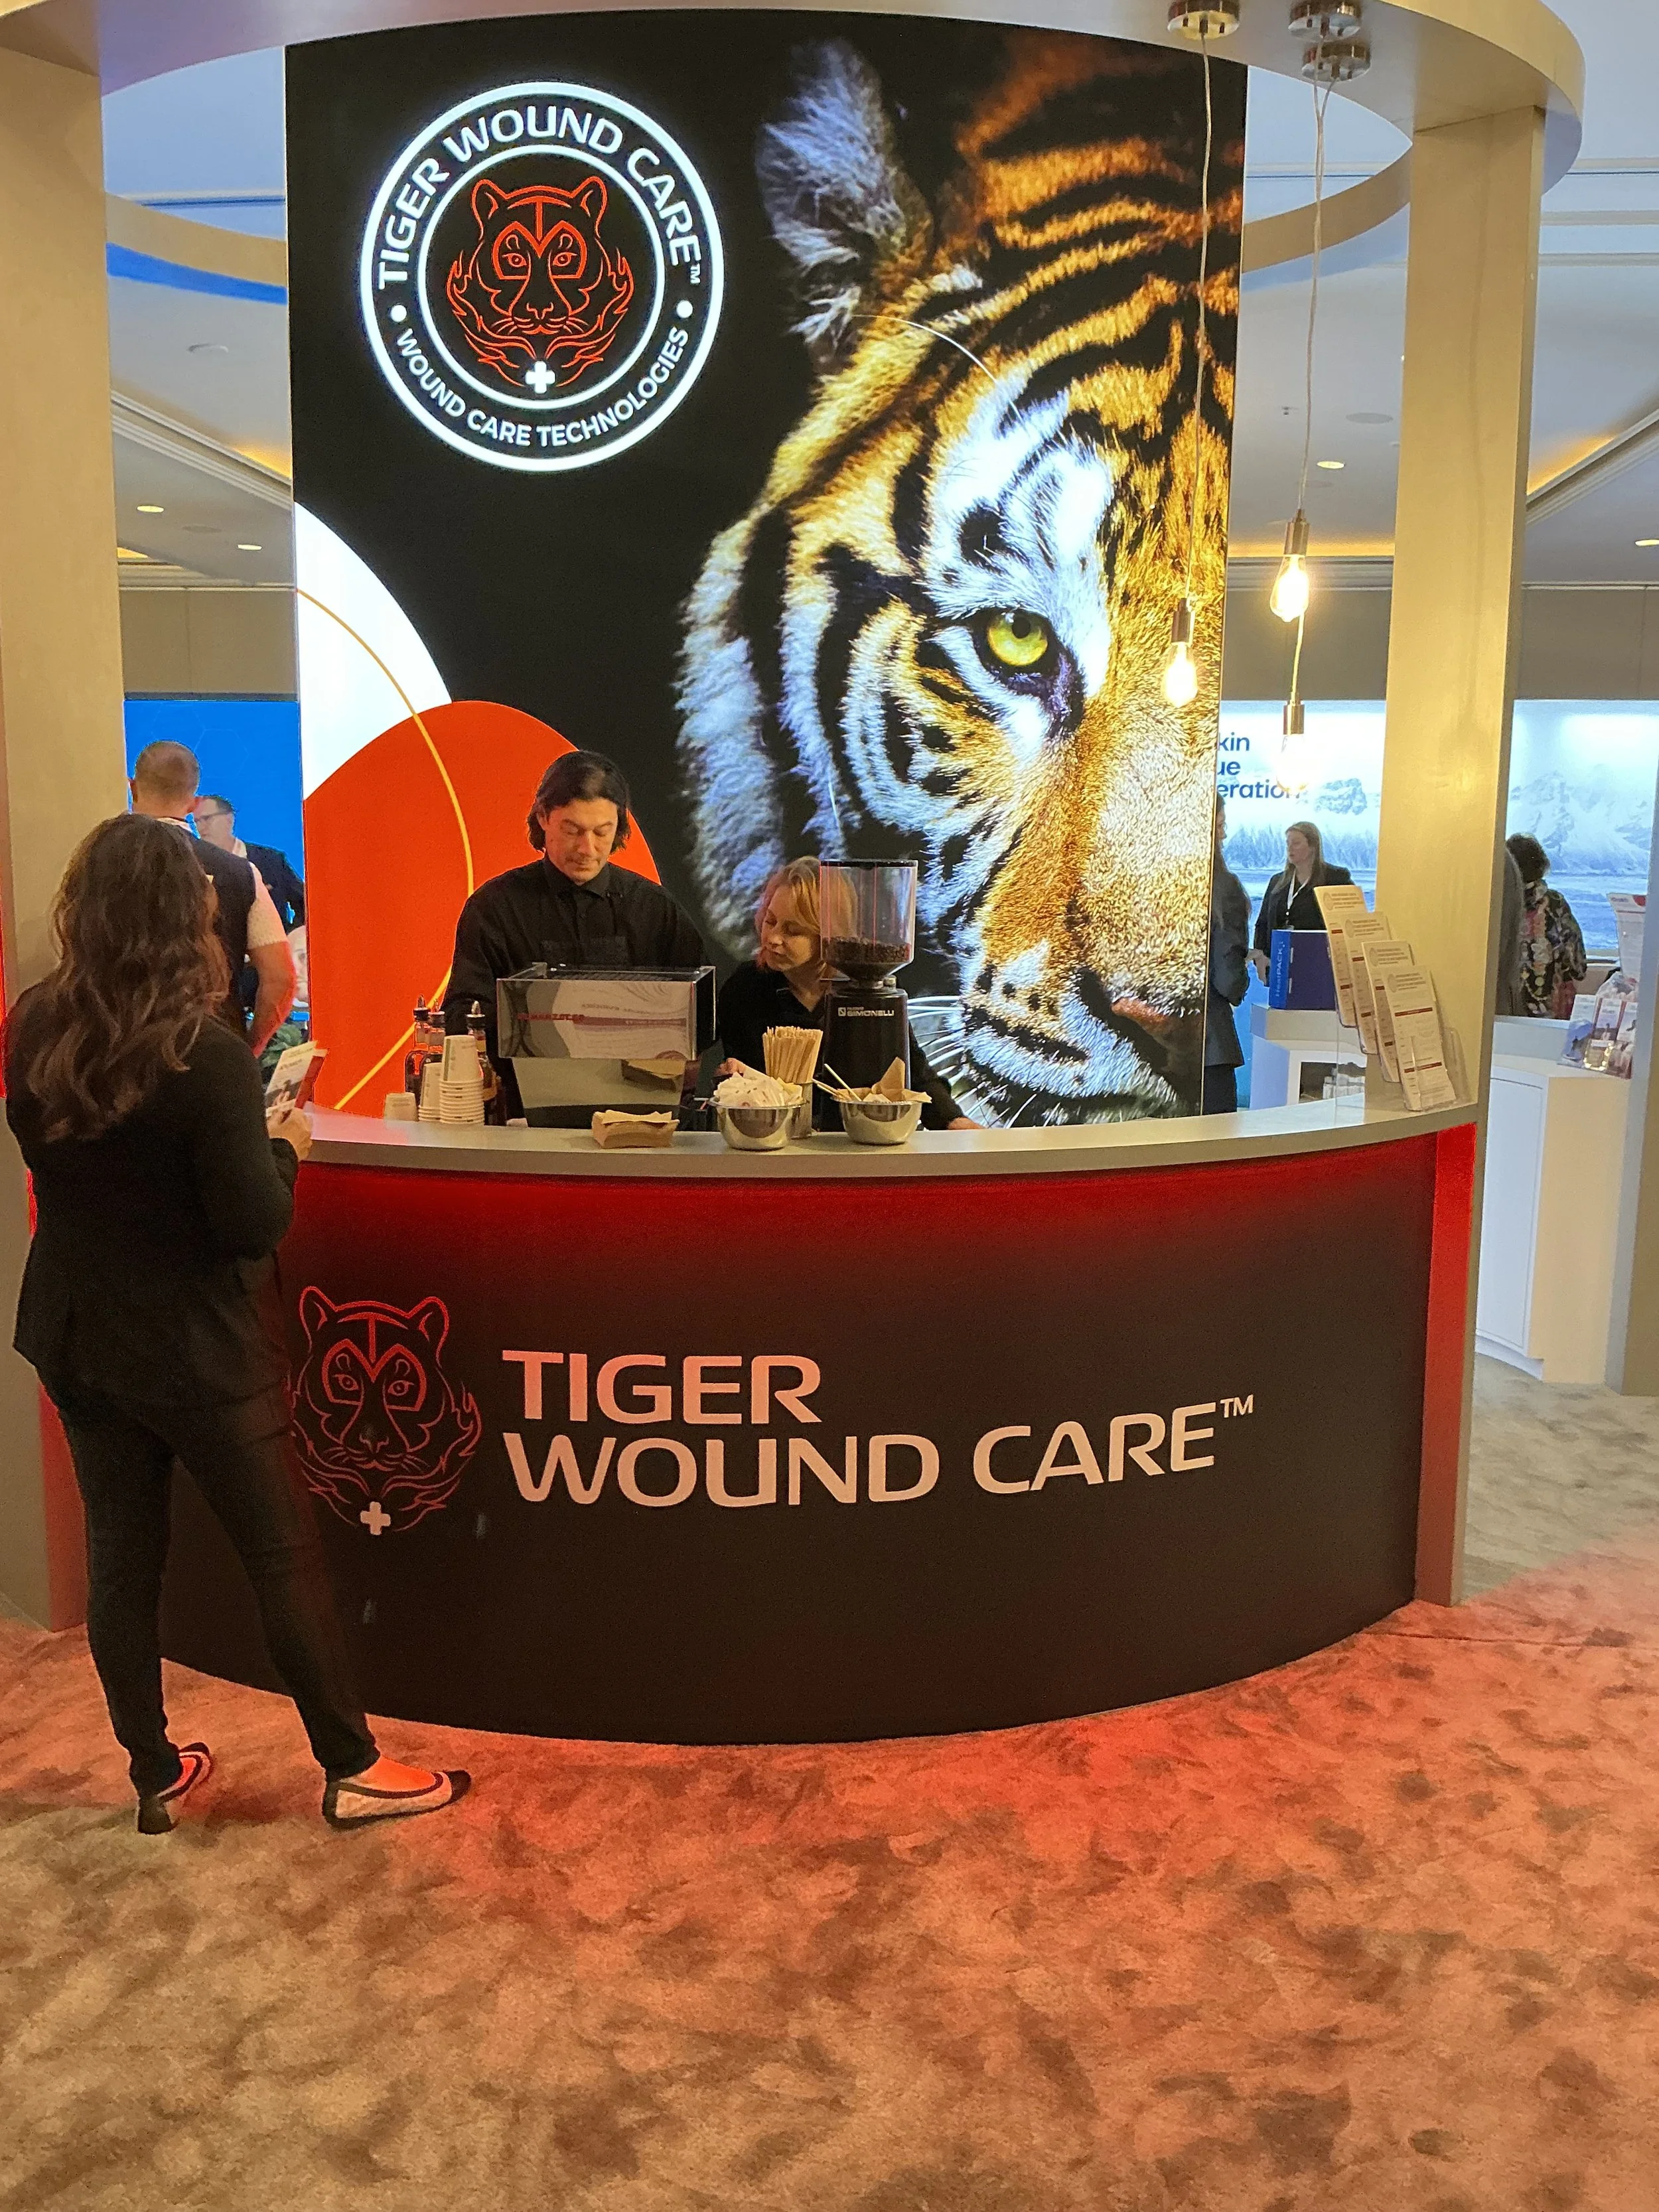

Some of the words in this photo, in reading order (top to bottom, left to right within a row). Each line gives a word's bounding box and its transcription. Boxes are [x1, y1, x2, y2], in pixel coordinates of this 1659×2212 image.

[378, 158, 451, 290] TIGER
[442, 106, 623, 163] WOUND
[396, 328, 466, 417] WOUND
[467, 409, 532, 447] CARE
[536, 326, 689, 447] TECHNOLOGIES
[502, 1350, 822, 1425] TIGER
[502, 1432, 940, 1508] WOUND
